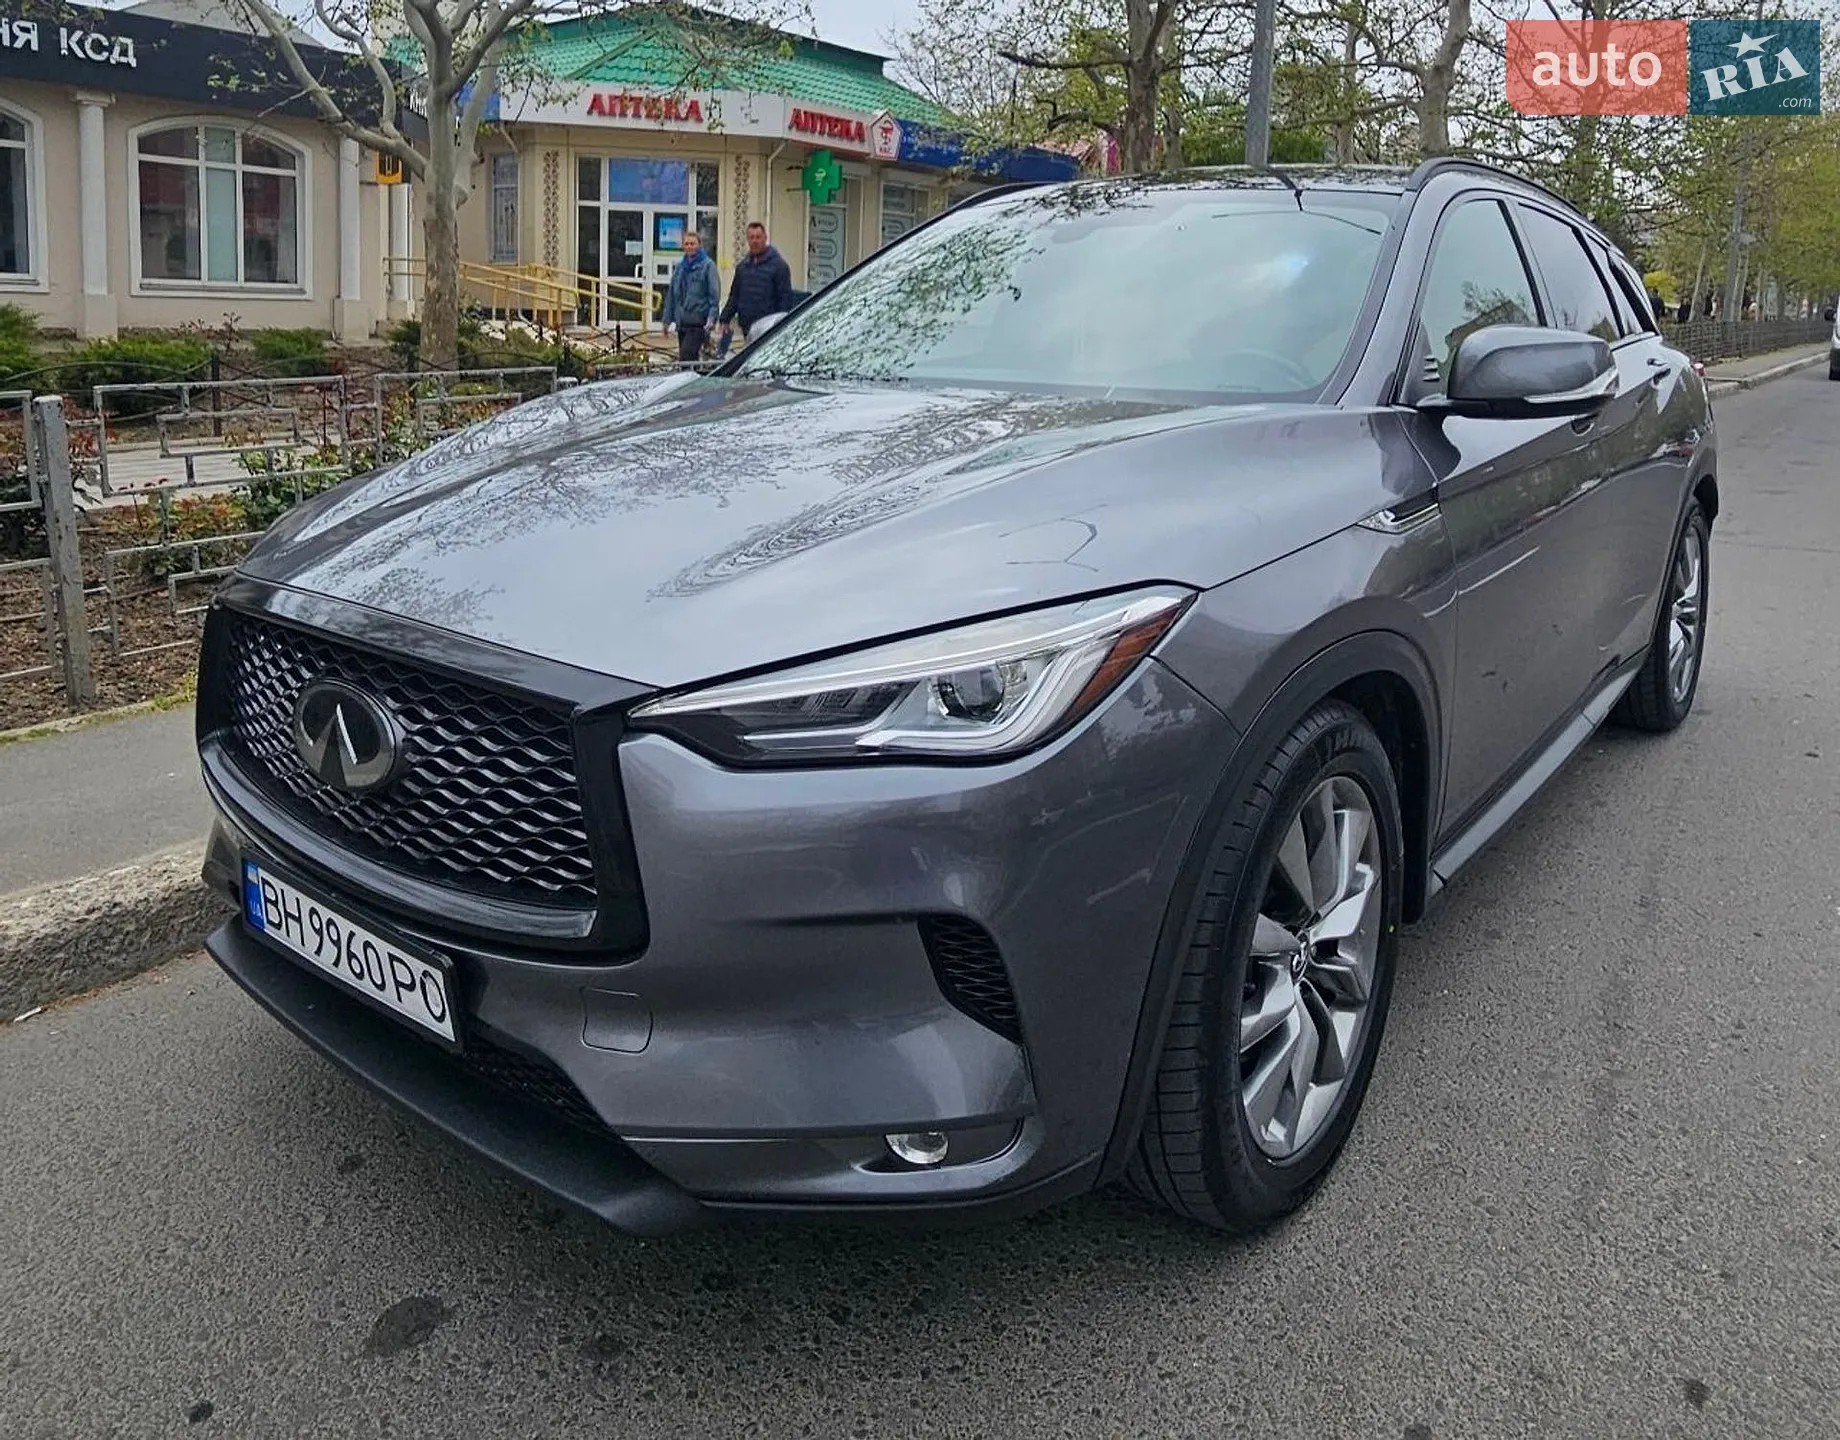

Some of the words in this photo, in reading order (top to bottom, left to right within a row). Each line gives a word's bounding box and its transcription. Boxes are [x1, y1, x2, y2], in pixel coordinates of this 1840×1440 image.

[60, 27, 137, 68] КСД
[586, 93, 704, 124] АПТЕКА
[788, 107, 866, 144] АПТЕКА
